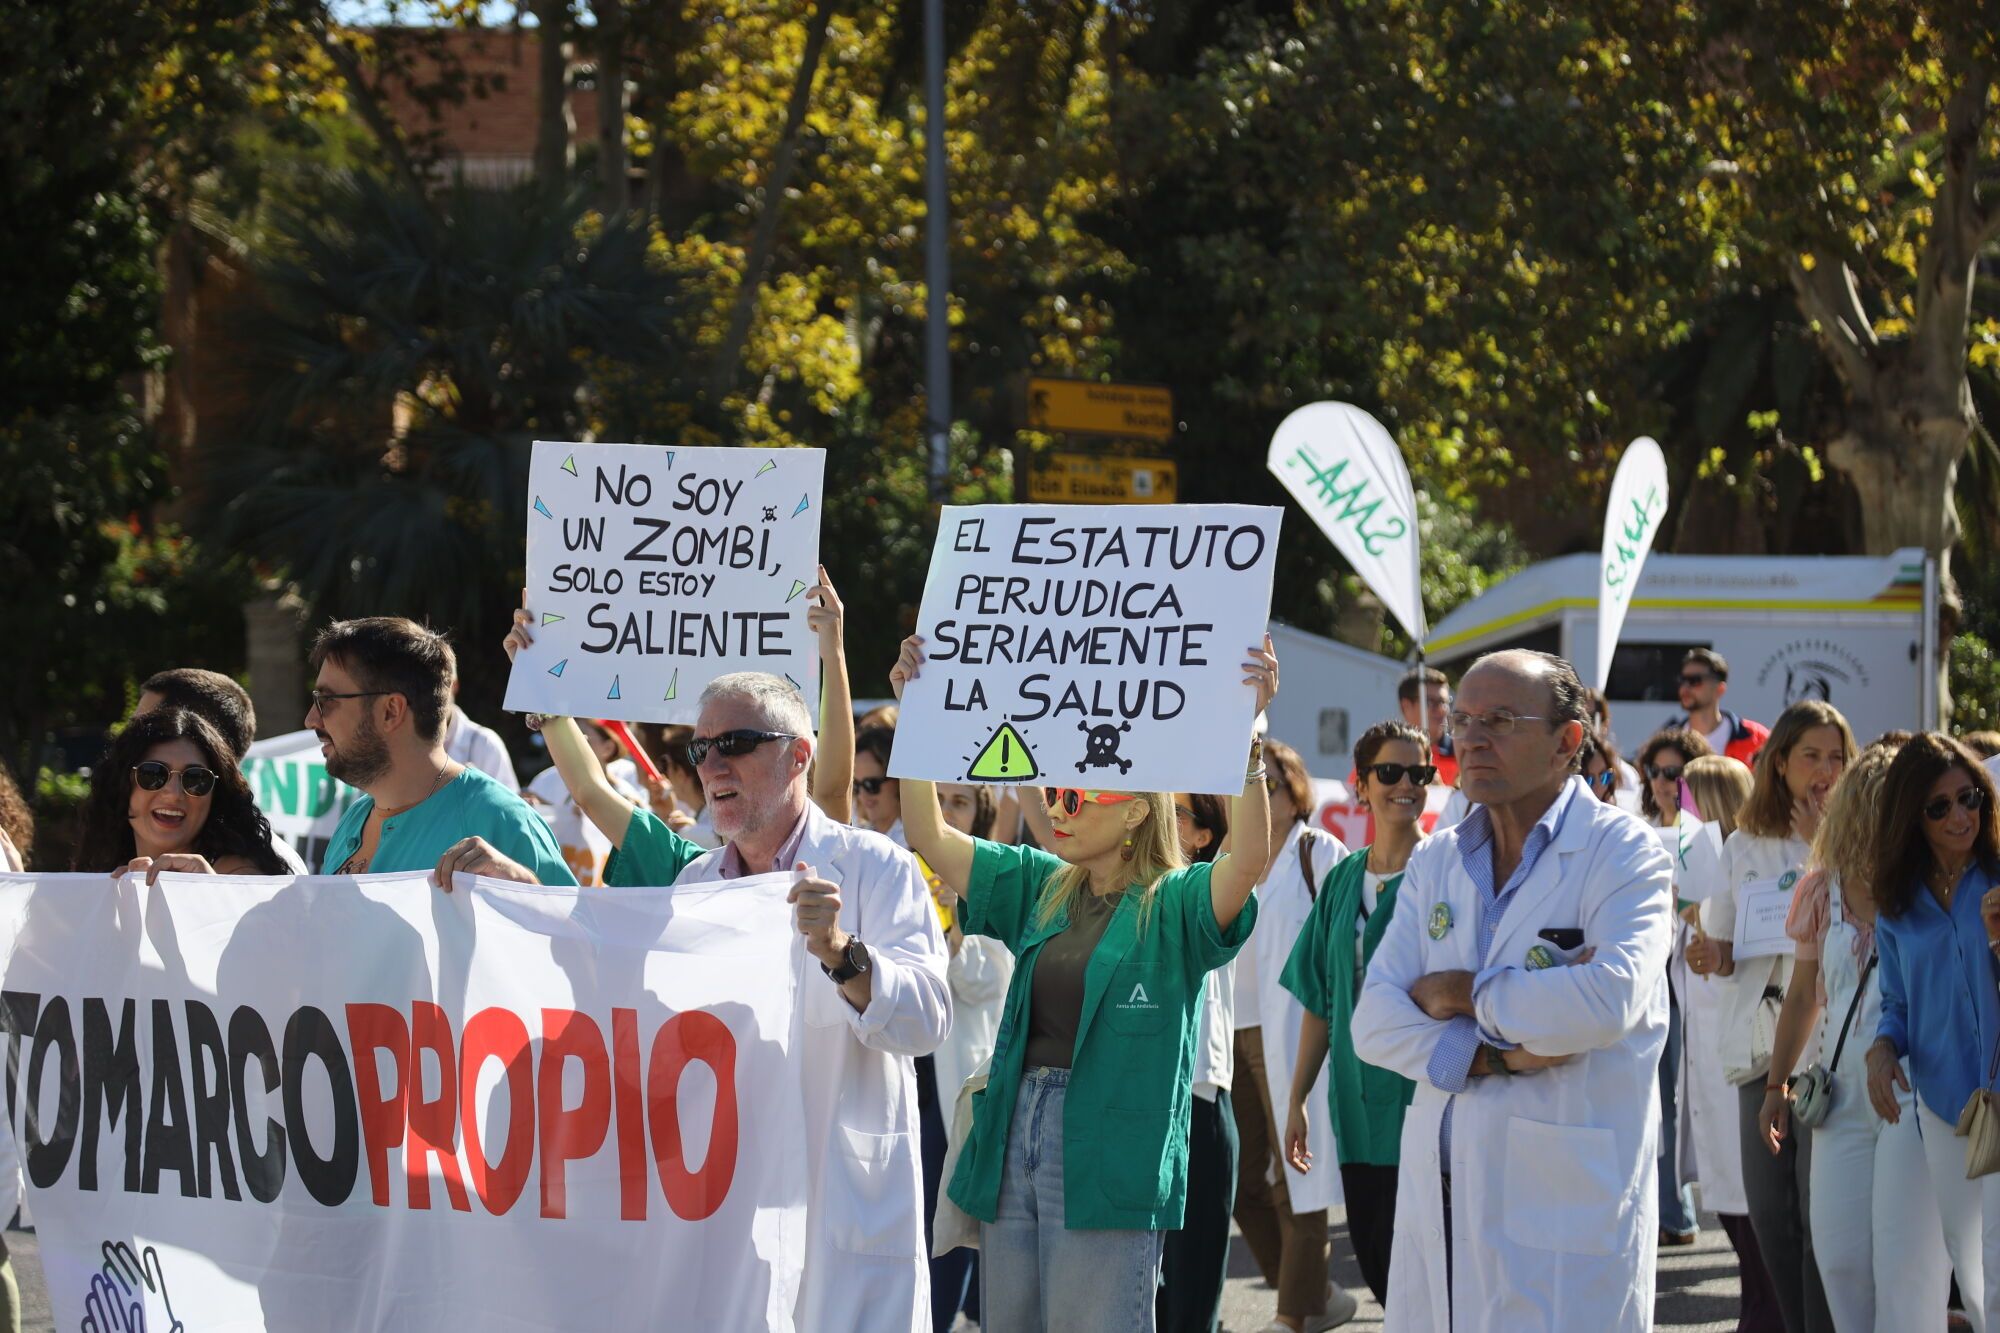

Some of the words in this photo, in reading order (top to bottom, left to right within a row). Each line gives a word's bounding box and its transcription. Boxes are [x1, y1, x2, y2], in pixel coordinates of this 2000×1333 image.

[595, 464, 652, 507] NO
[672, 472, 744, 516] SOY
[563, 516, 606, 552] UN
[953, 518, 991, 553] EL
[1011, 517, 1265, 571] ESTATUTO
[548, 564, 624, 595] SOLO
[639, 571, 716, 598] ESTOY
[955, 574, 1184, 619] PERJUDICA
[580, 602, 792, 658] SALIENTE
[928, 620, 1213, 667] SERIAMENTE
[944, 678, 989, 712] LA
[1010, 673, 1187, 722] SALUD
